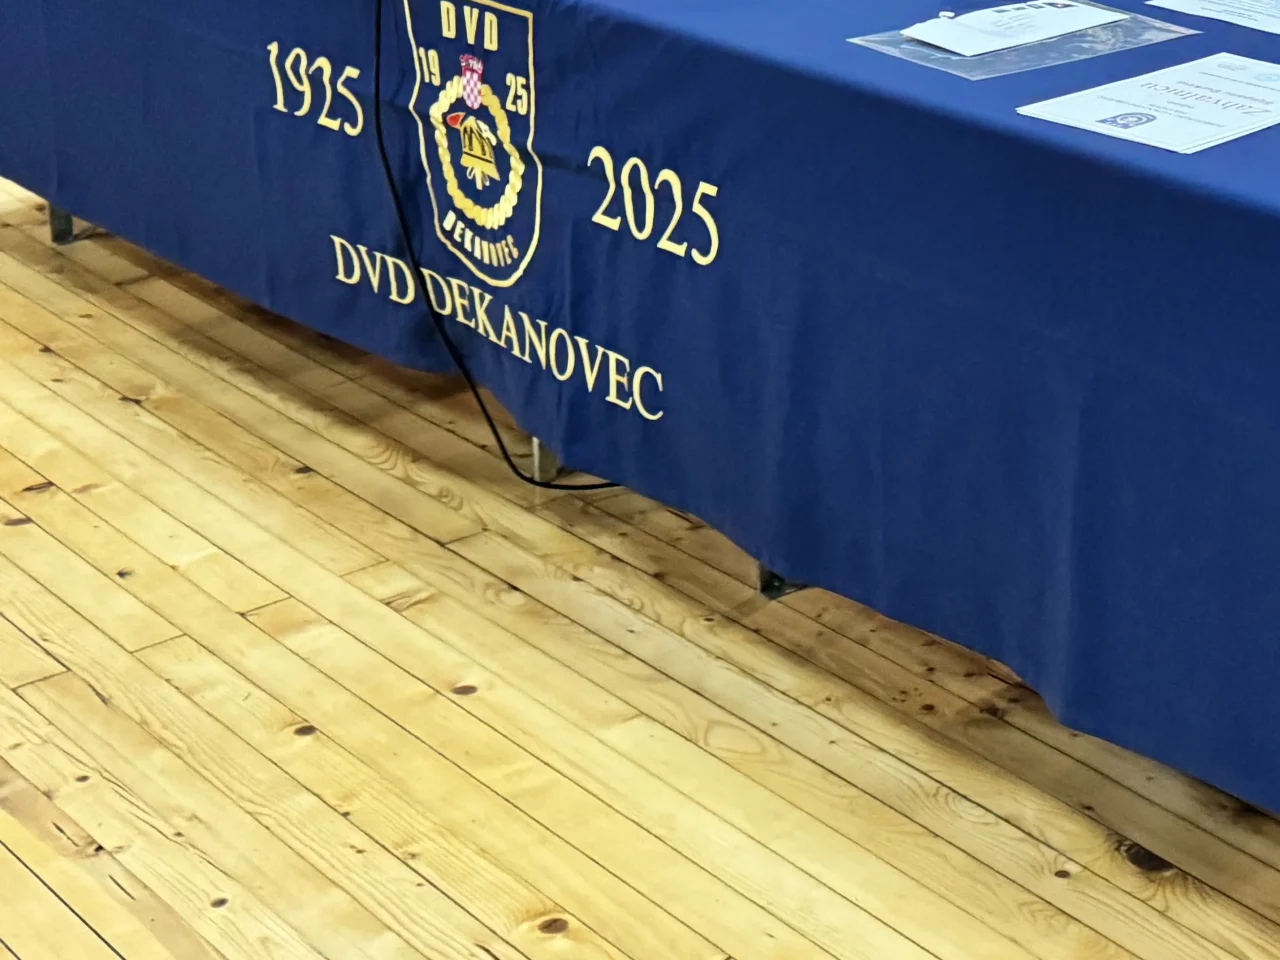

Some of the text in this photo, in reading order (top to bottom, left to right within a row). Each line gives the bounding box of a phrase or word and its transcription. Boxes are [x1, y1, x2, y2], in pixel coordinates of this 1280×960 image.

[440, 0, 500, 52] DVD
[266, 41, 364, 137] 1925
[419, 47, 440, 86] 19
[505, 73, 529, 116] 25
[588, 146, 718, 265] 2025
[331, 236, 664, 421] DVD DEKANOVEC
